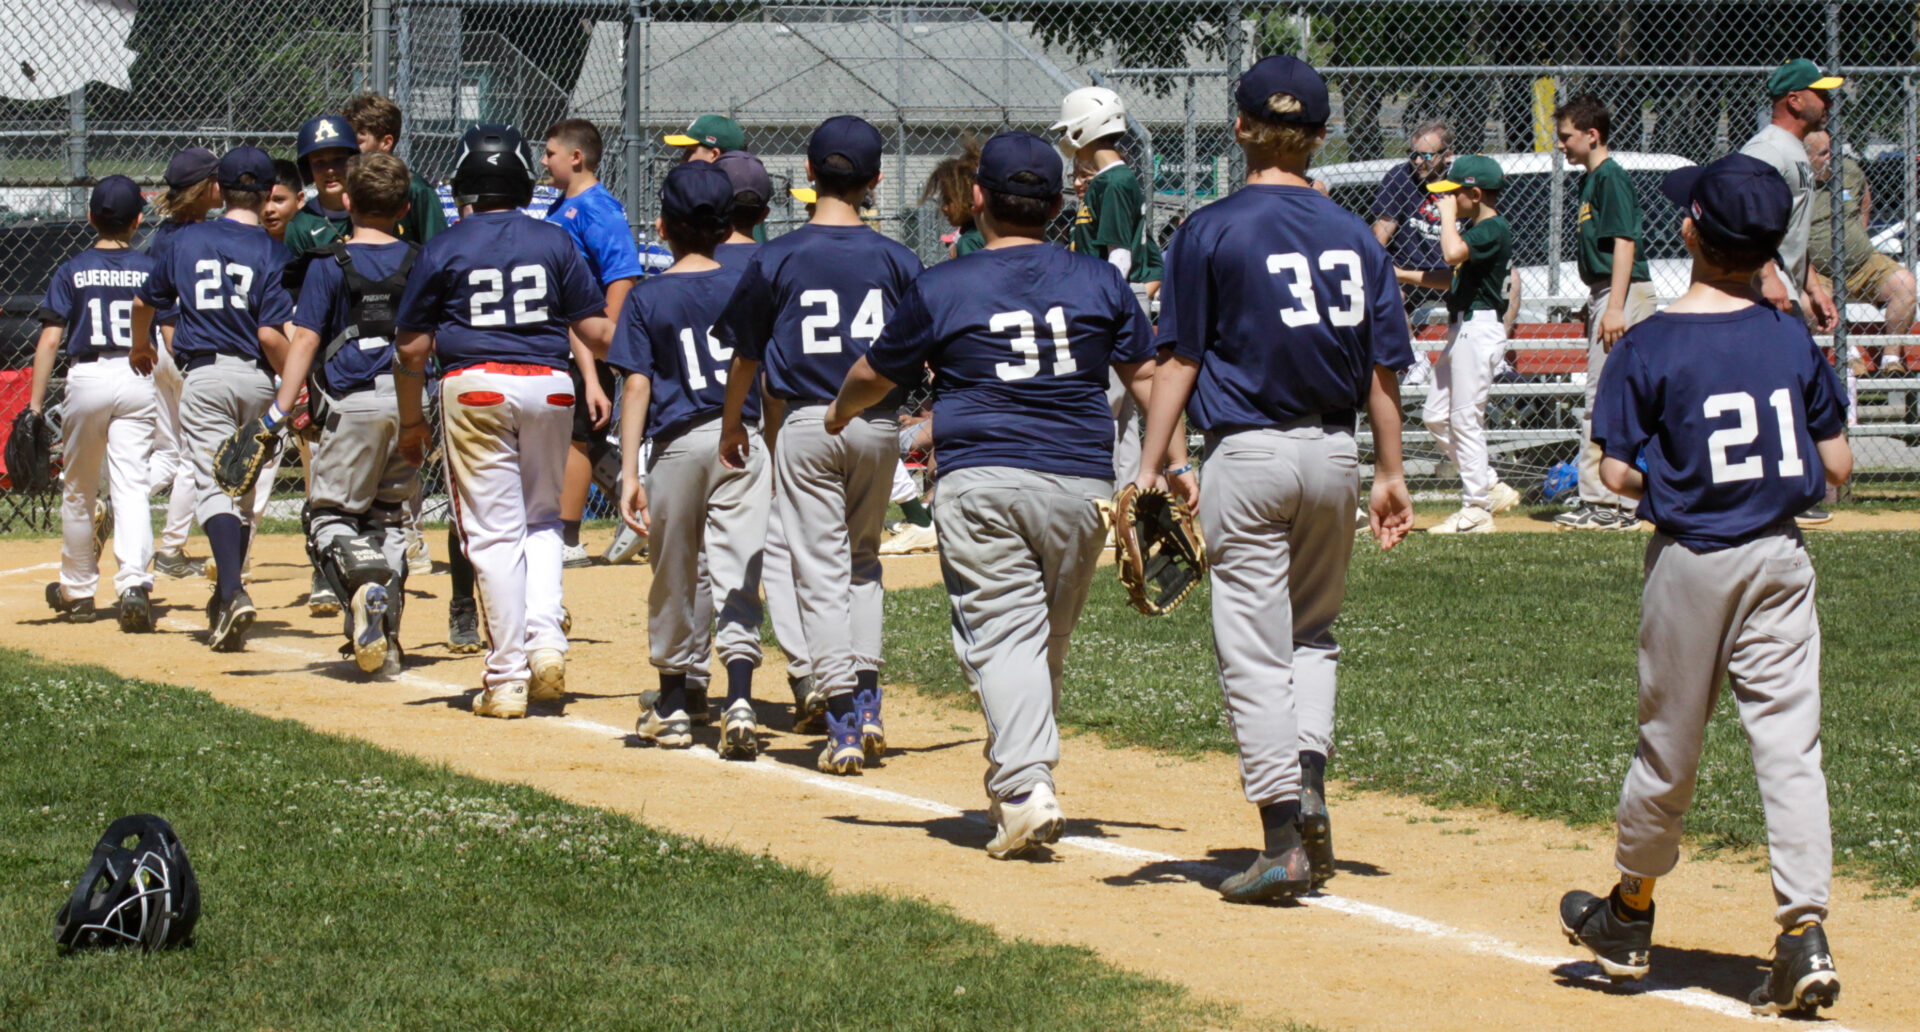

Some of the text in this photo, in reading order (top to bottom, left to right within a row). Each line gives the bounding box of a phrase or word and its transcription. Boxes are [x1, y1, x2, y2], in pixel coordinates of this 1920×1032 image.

[314, 118, 340, 143] A
[195, 259, 253, 310] 23
[468, 263, 549, 327] 22
[1266, 250, 1366, 328] 33
[799, 288, 886, 355] 24
[988, 305, 1077, 382] 31
[1703, 387, 1804, 484] 21
